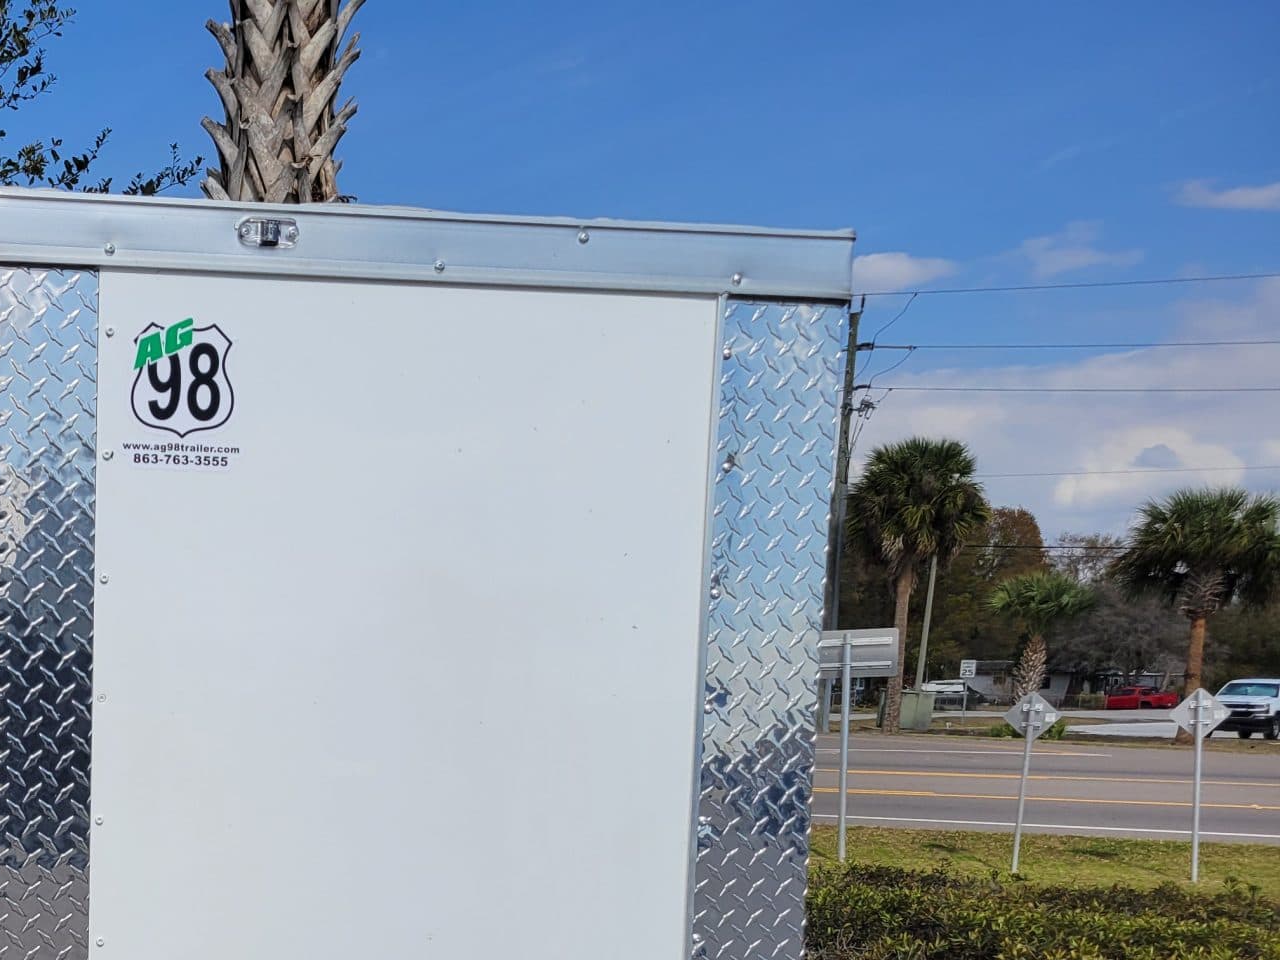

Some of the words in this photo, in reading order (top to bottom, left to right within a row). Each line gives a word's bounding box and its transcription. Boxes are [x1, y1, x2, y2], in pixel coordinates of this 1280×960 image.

[133, 317, 194, 371] AG
[147, 342, 221, 422] 98
[122, 441, 240, 454] www.ag98trailer.com
[133, 453, 228, 467] 863-763-3555
